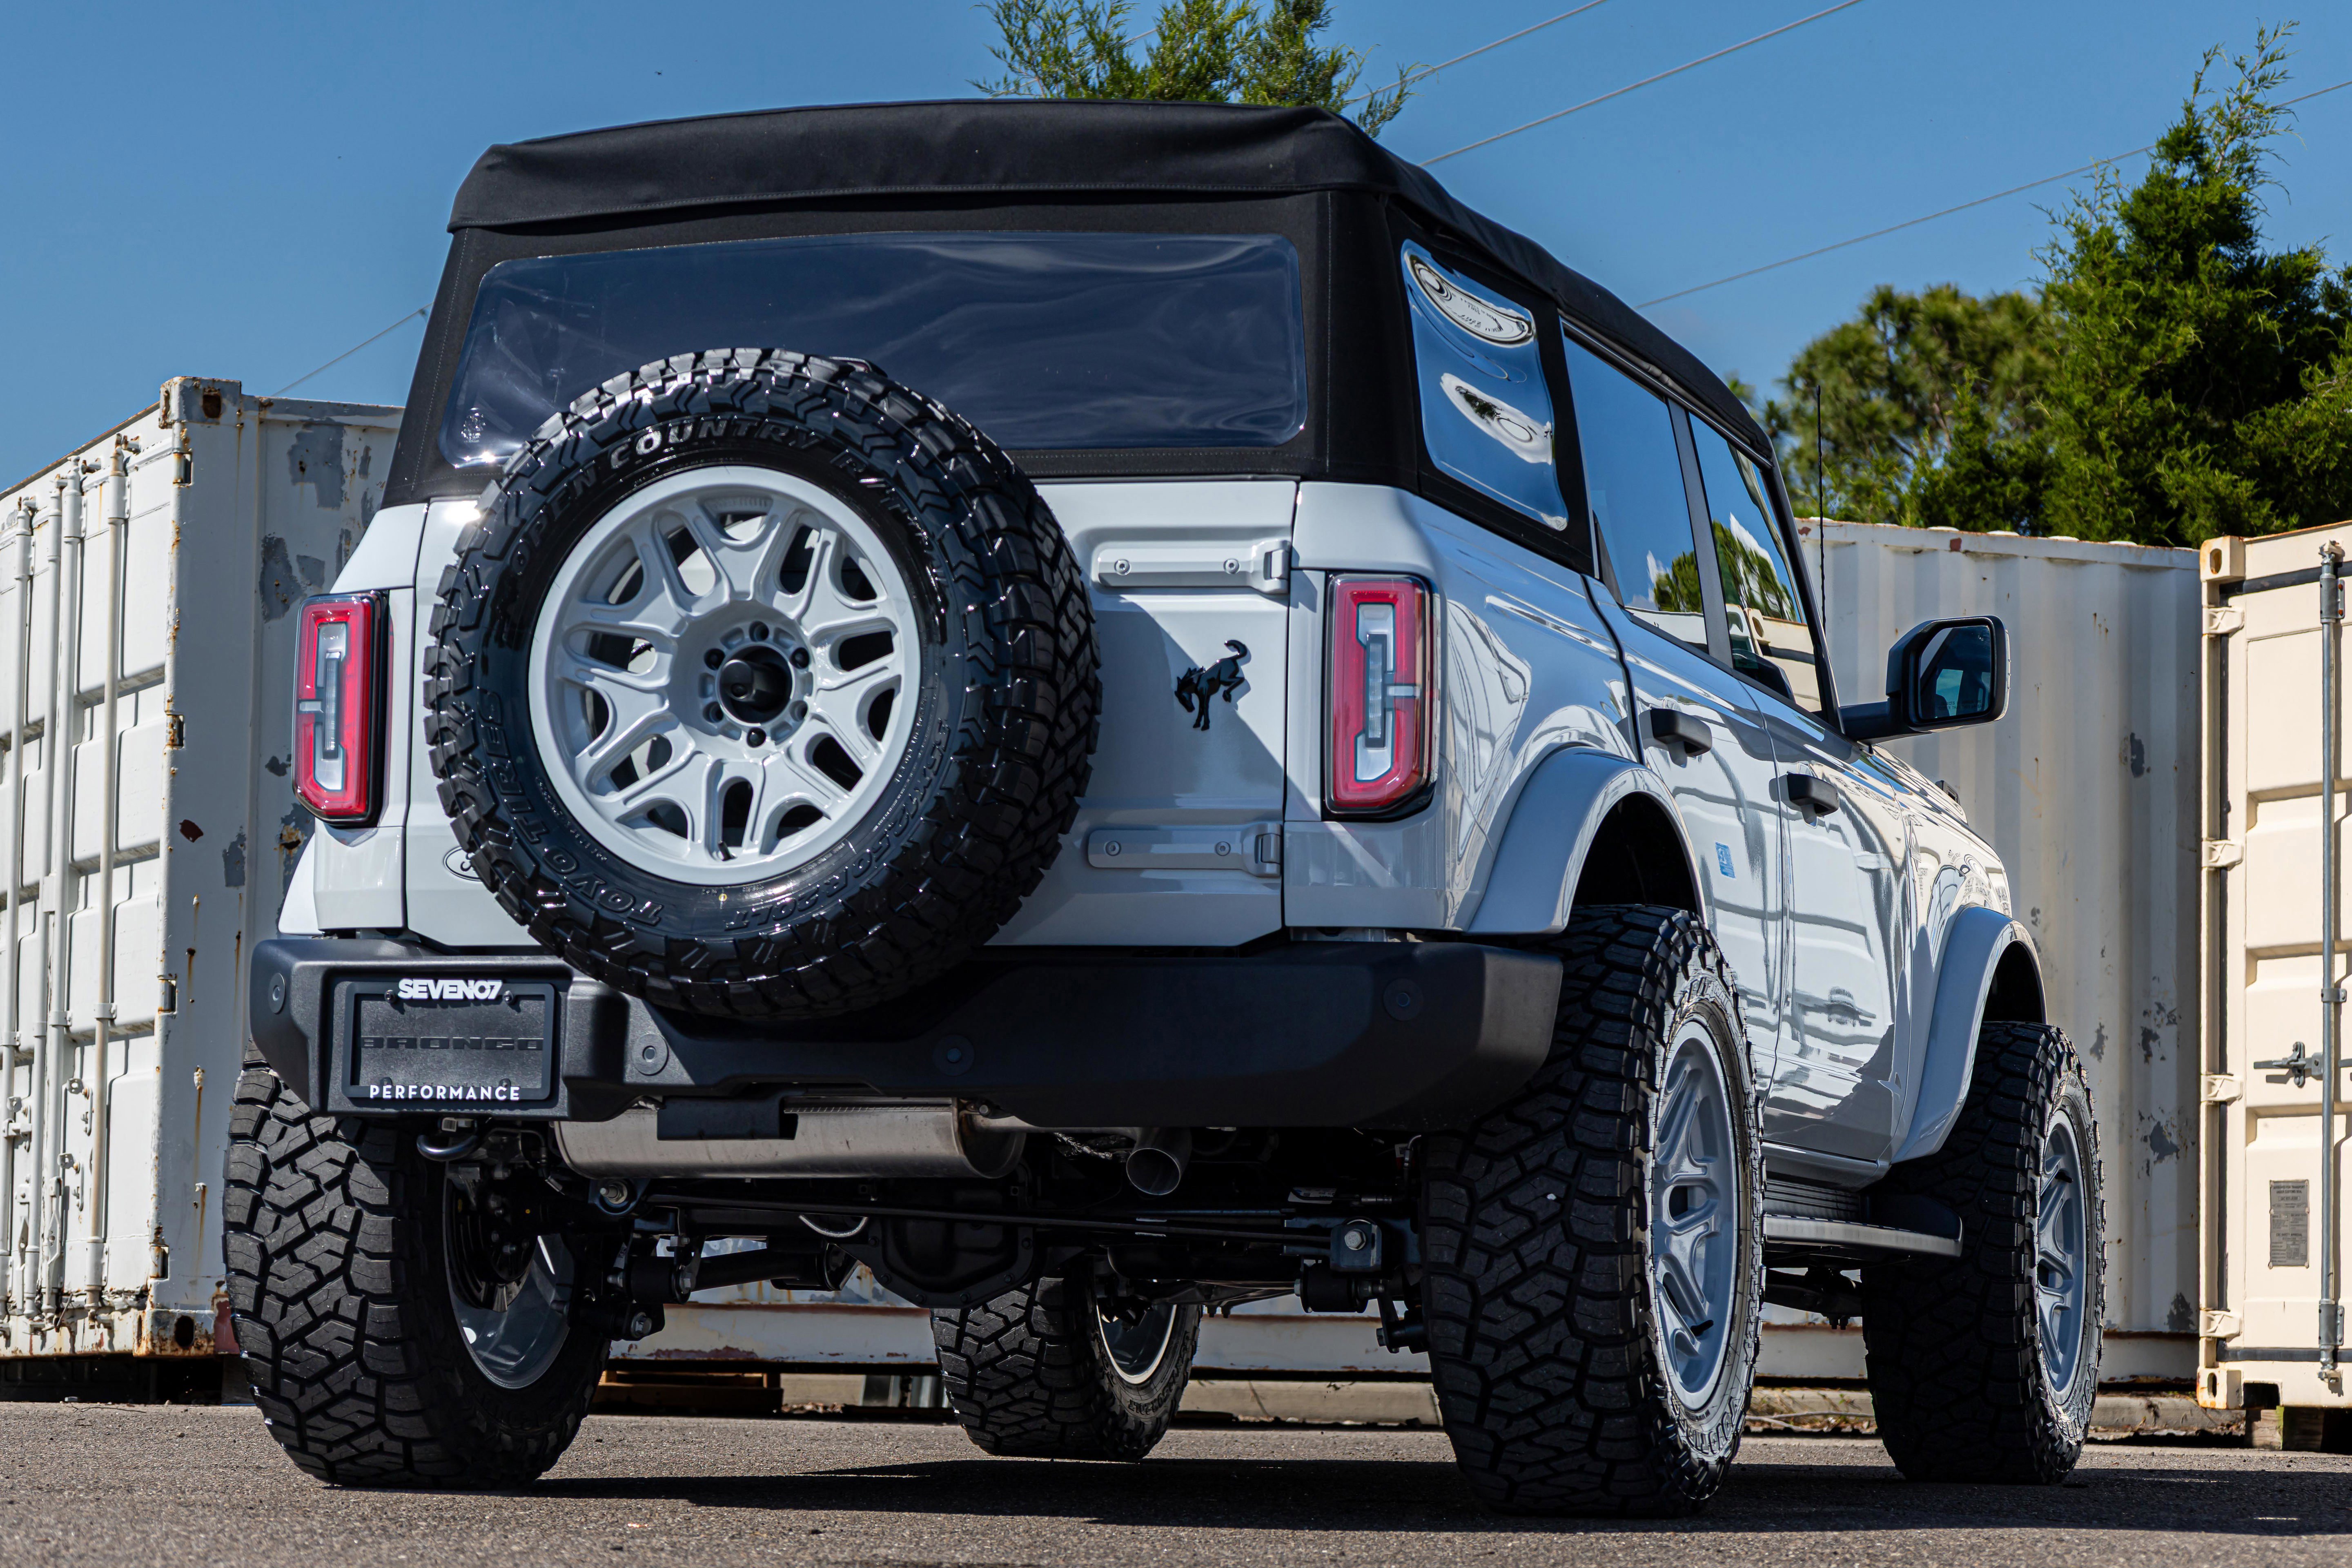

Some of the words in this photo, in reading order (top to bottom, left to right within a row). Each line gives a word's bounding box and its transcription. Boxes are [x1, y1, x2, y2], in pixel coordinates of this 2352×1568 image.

[510, 467, 597, 575] OPEN
[610, 416, 820, 470] COUNTRY
[477, 686, 549, 844] TIRES
[542, 844, 664, 927] TOYO
[361, 1035, 544, 1051] BRONCO
[370, 1084, 520, 1101] PERFORMANCE
